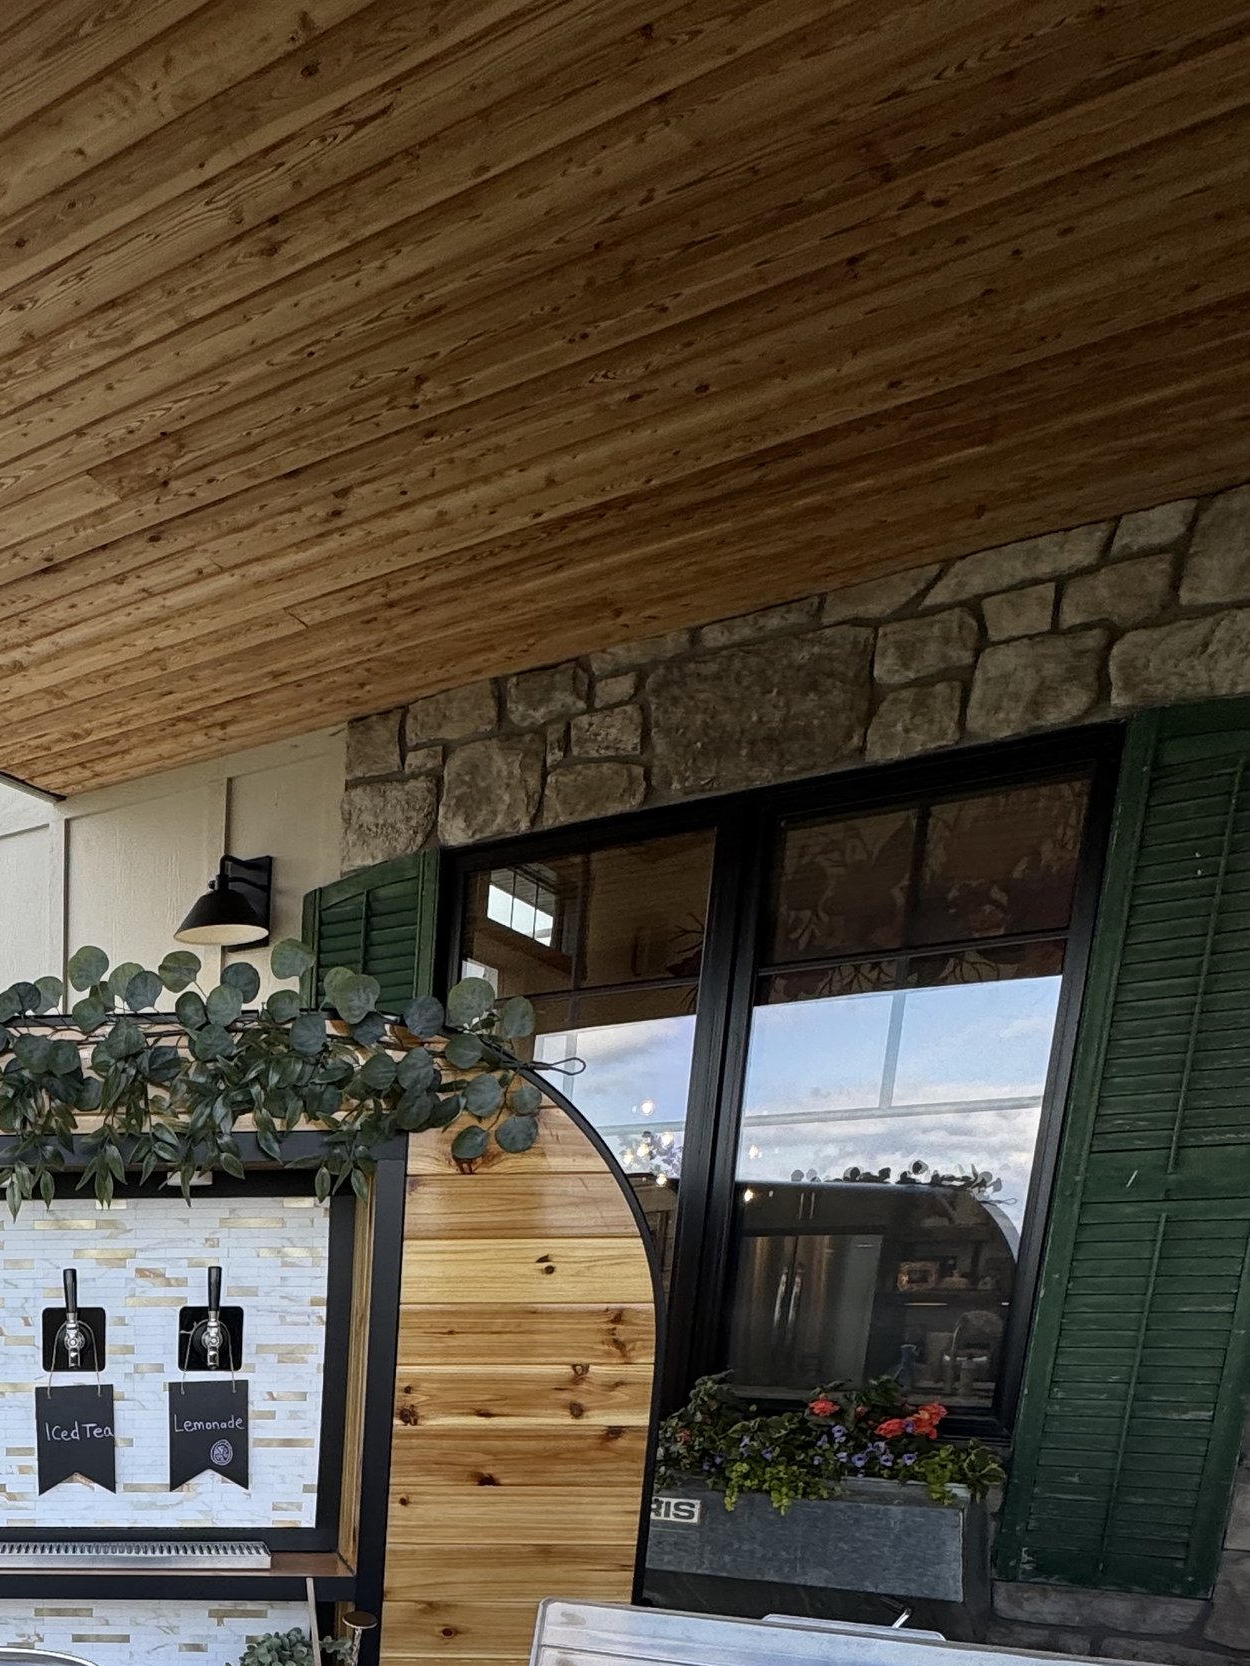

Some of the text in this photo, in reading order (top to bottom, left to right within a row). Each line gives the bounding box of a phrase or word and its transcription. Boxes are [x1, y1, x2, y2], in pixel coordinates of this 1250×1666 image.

[45, 1420, 115, 1441] Iced Tea
[173, 1414, 245, 1433] Lemonade
